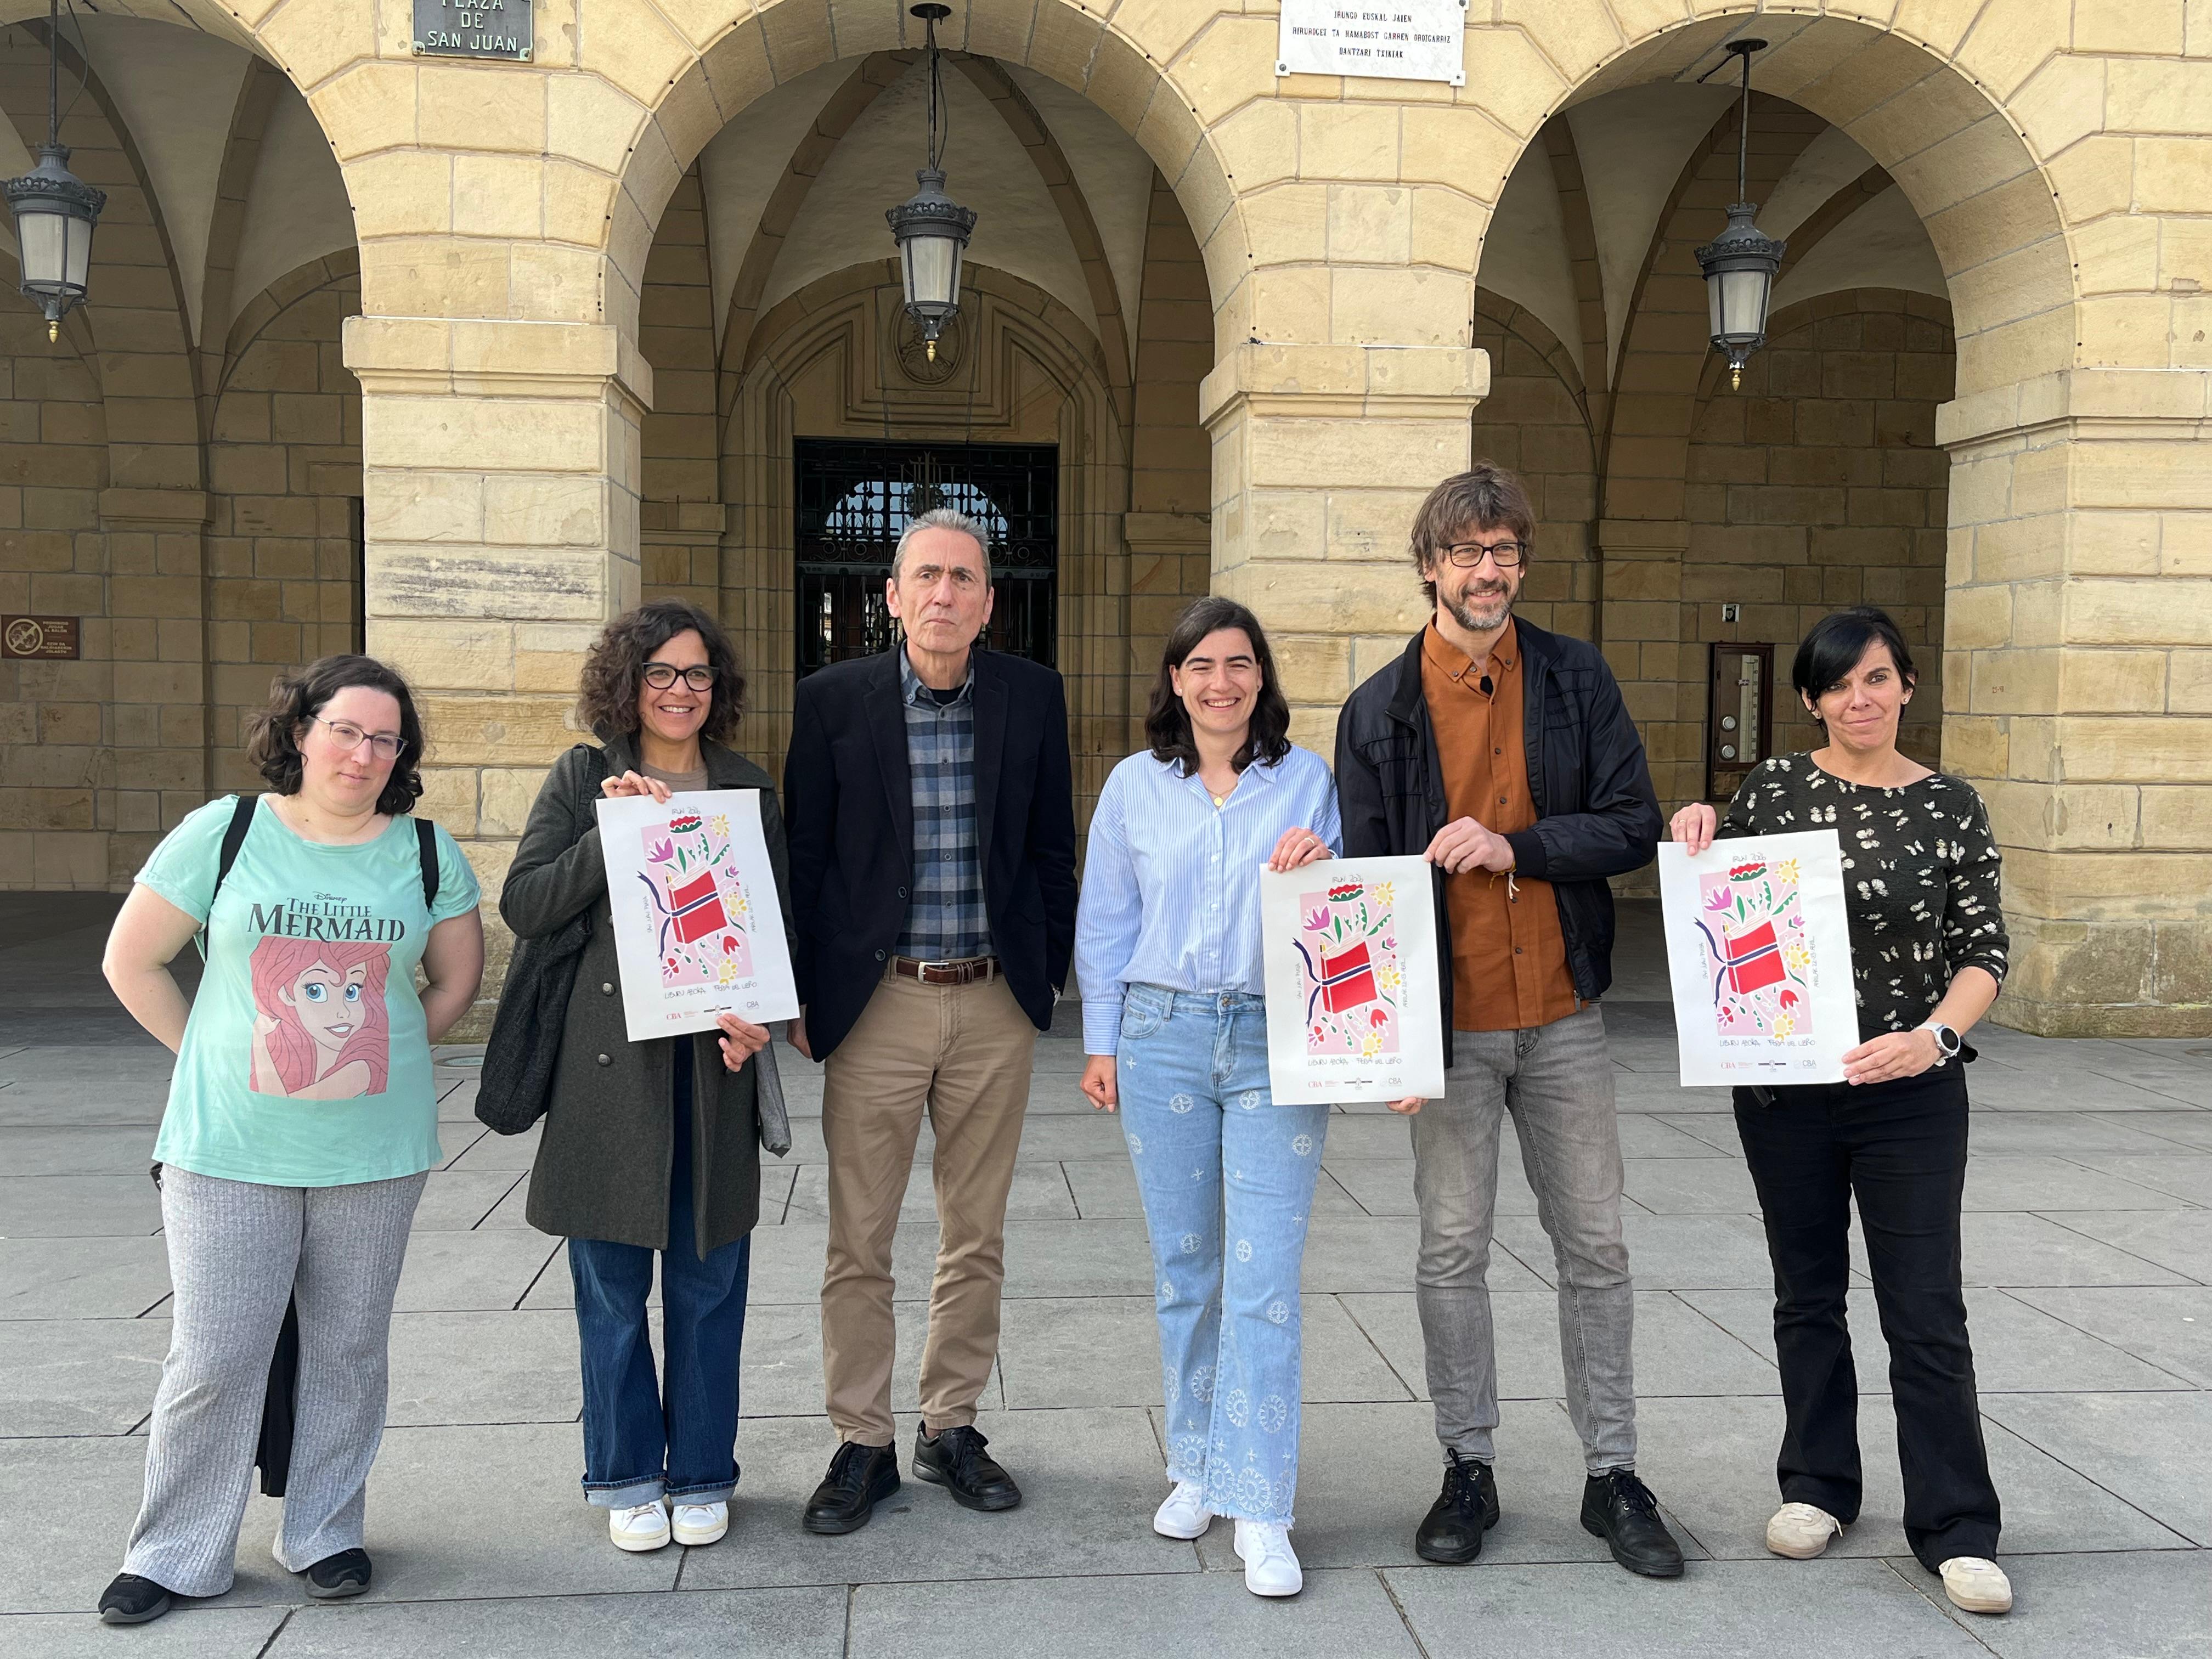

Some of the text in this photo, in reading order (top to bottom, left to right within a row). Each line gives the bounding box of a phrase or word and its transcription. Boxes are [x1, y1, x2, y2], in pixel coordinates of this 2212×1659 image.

[461, 12, 483, 28] DE
[1334, 11, 1412, 22] IRUNGO EUSKAL JAIEN
[428, 31, 517, 52] SAN JUAN
[1293, 27, 1327, 36] HIRUROGEI
[1332, 29, 1340, 37] TA
[1345, 30, 1379, 40] HAMABOST
[1414, 33, 1451, 43] OROIGARRIZ
[1339, 47, 1403, 59] DANTZARI TXIKIAK
[287, 898, 372, 917] THE LITTLE
[247, 903, 405, 943] MERMAID
